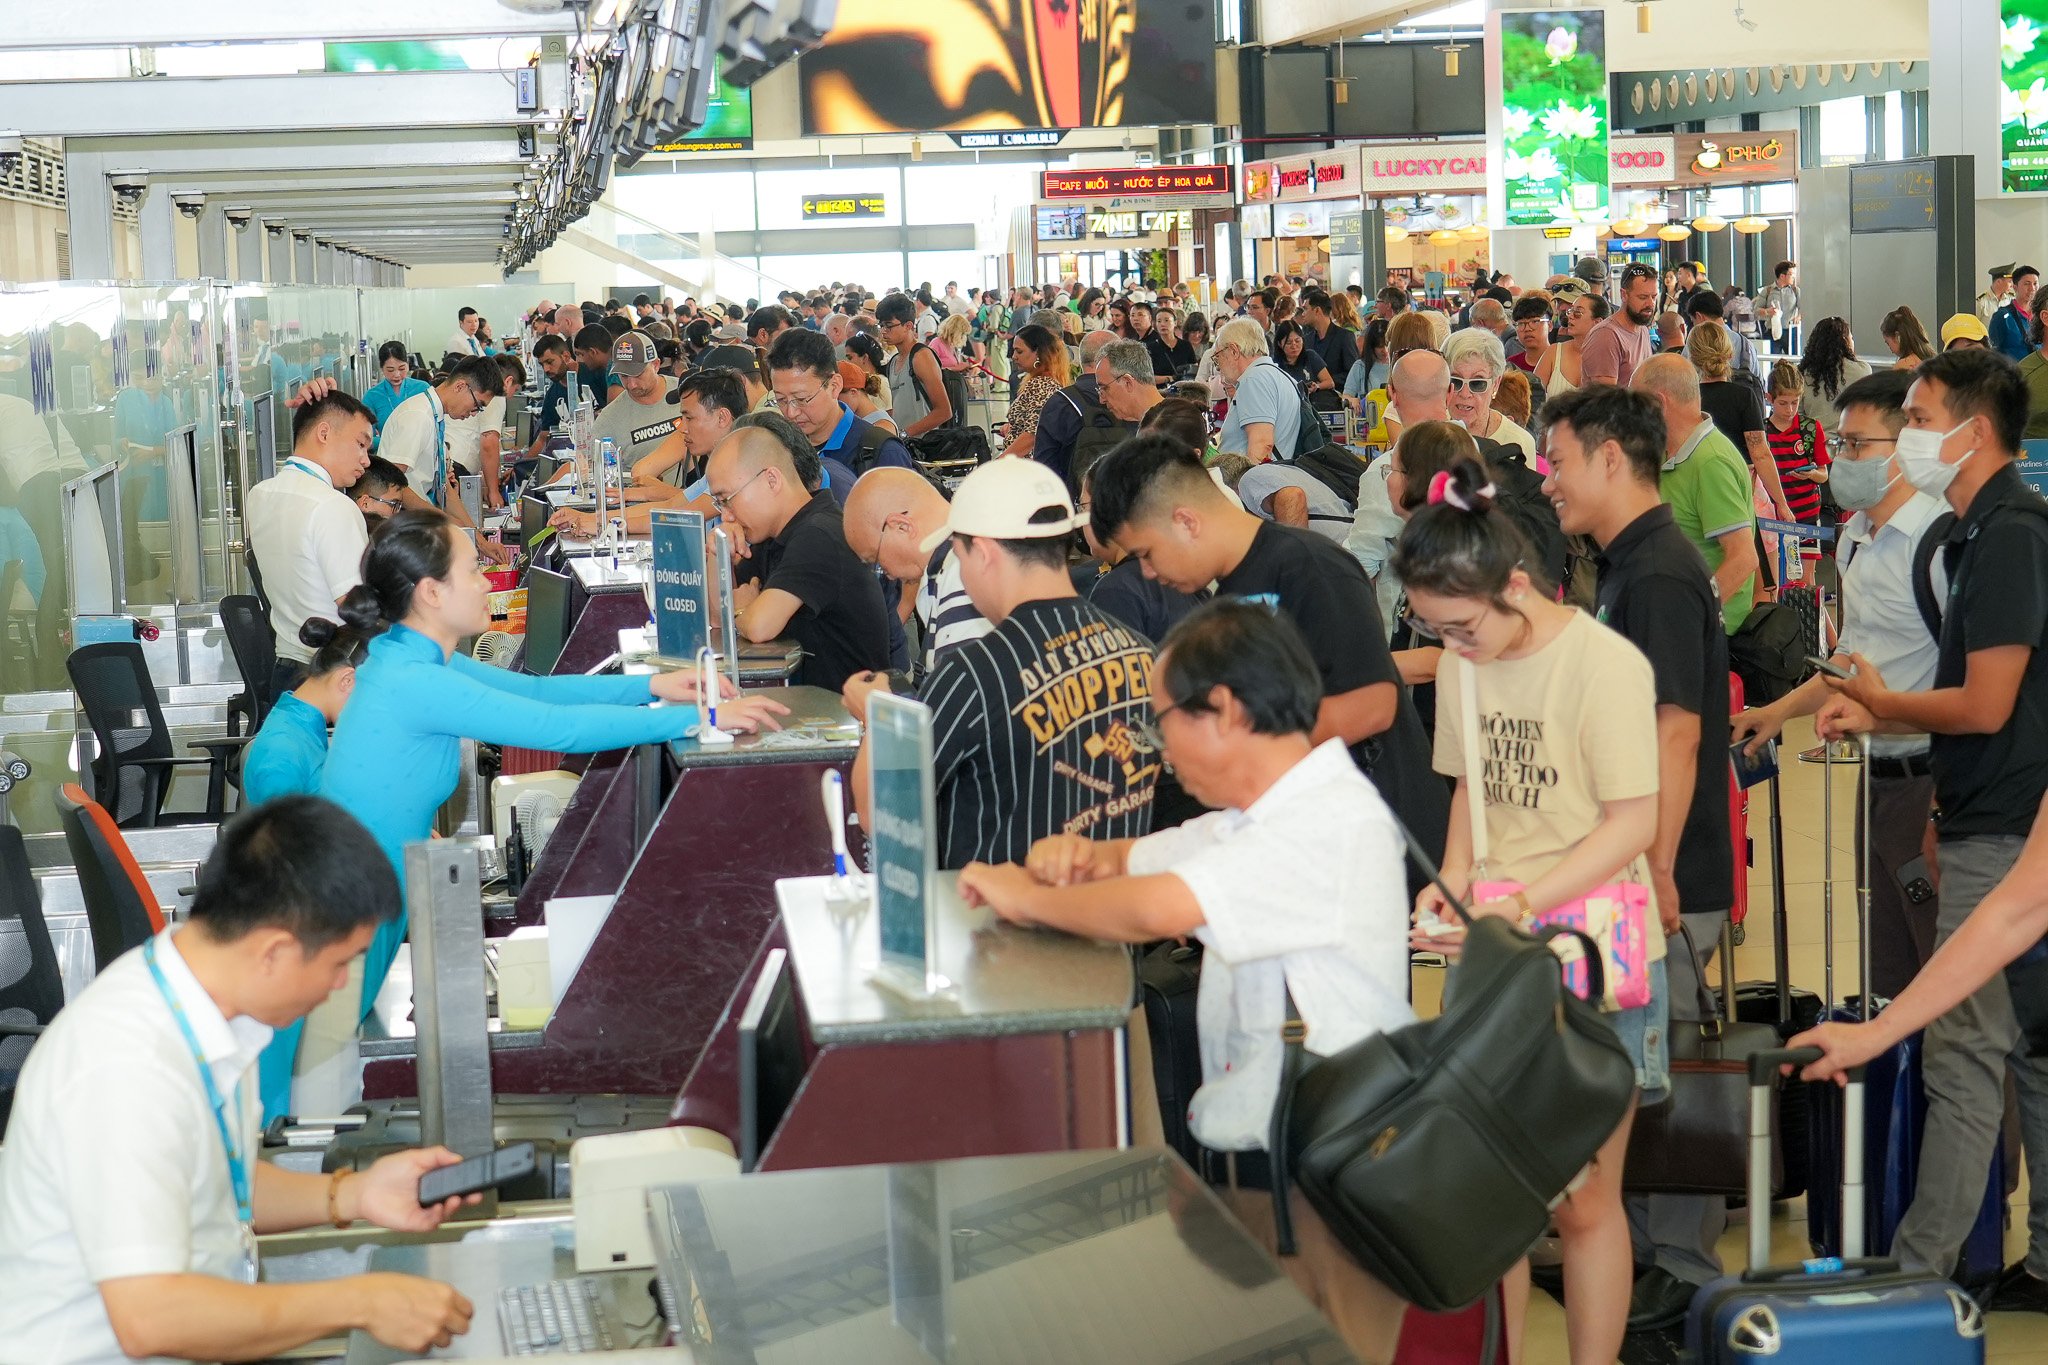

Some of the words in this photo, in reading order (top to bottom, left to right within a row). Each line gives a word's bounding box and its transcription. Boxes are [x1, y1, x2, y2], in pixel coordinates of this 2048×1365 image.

[1726, 138, 1783, 163] PHỞ
[1373, 157, 1447, 177] LUCKY
[1059, 180, 1082, 191] CAFE
[1085, 176, 1109, 190] MUỐI
[1123, 175, 1153, 189] NƯỚC
[1157, 176, 1171, 188] ÉP
[1174, 177, 1191, 187] HOA
[1141, 210, 1192, 233] CAFE
[633, 421, 675, 443] SWOOSH.
[656, 568, 680, 584] ĐÓNG
[664, 597, 697, 613] CLOSED
[1020, 651, 1063, 691] OLD
[1064, 627, 1138, 667] SCHOOL
[1487, 737, 1535, 762] WHO
